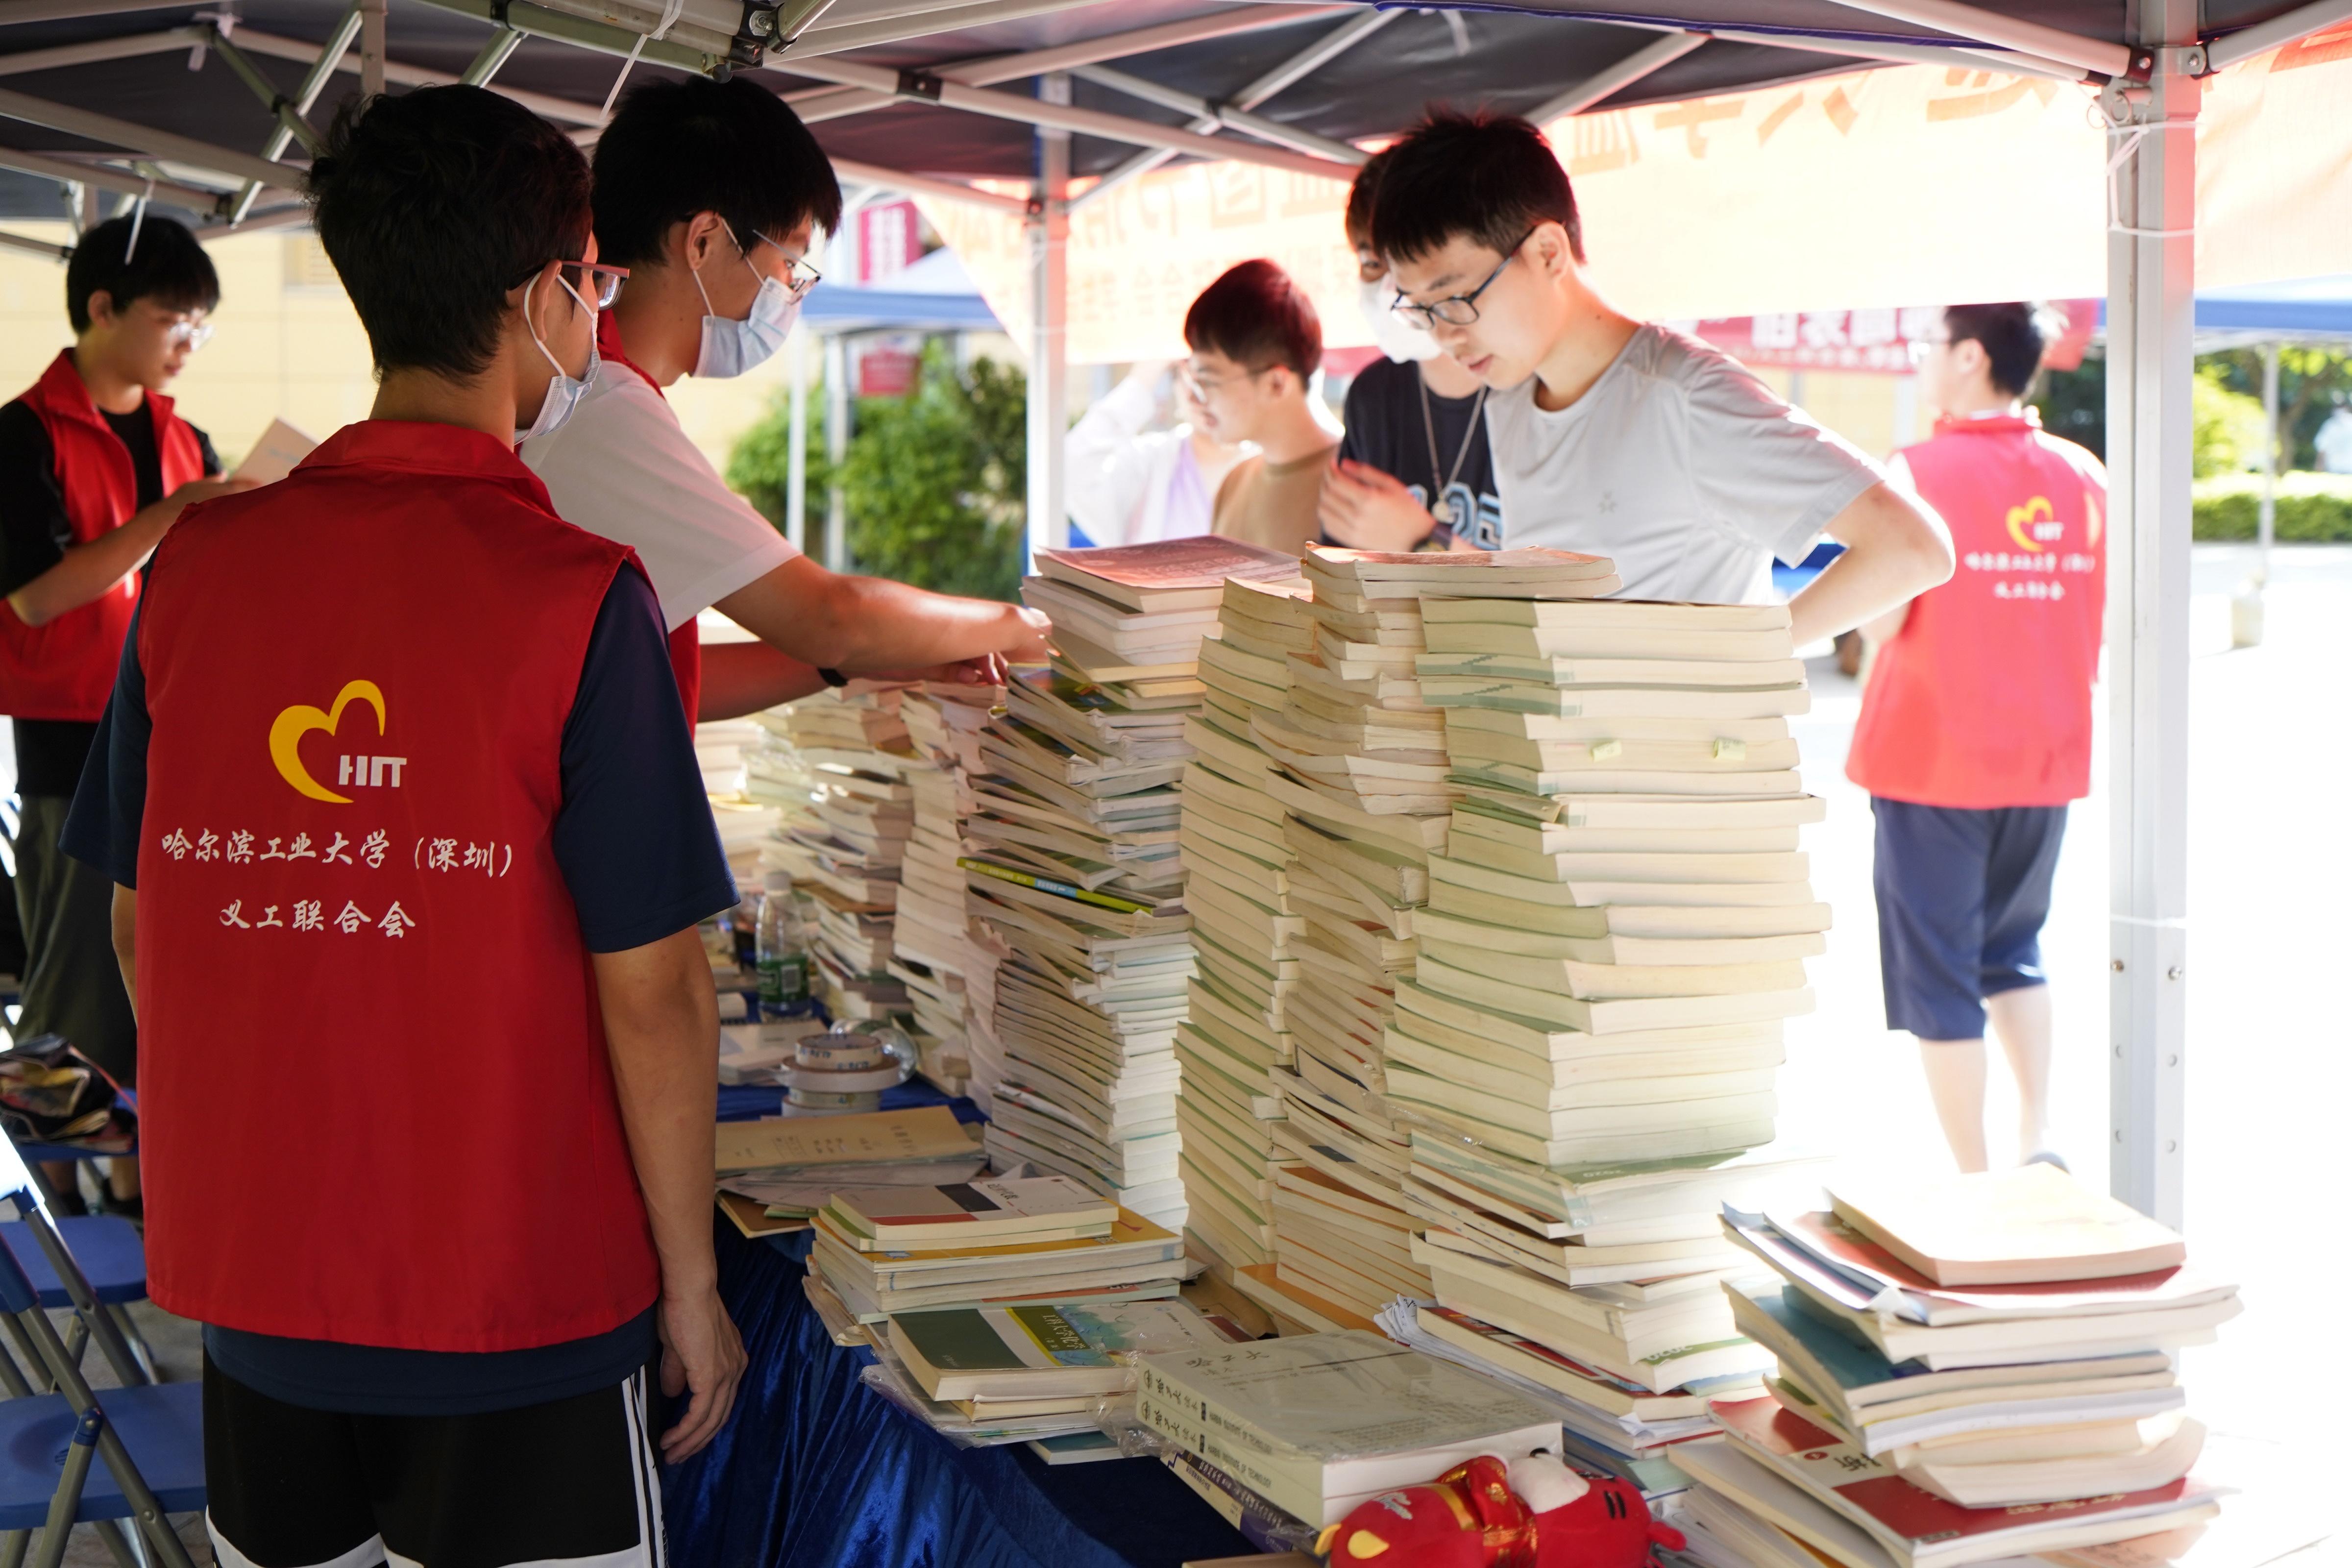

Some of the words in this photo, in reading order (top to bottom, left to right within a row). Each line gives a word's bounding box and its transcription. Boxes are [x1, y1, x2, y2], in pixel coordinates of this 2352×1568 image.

[339, 755, 407, 787] HIT
[219, 898, 416, 939] 义工联合会
